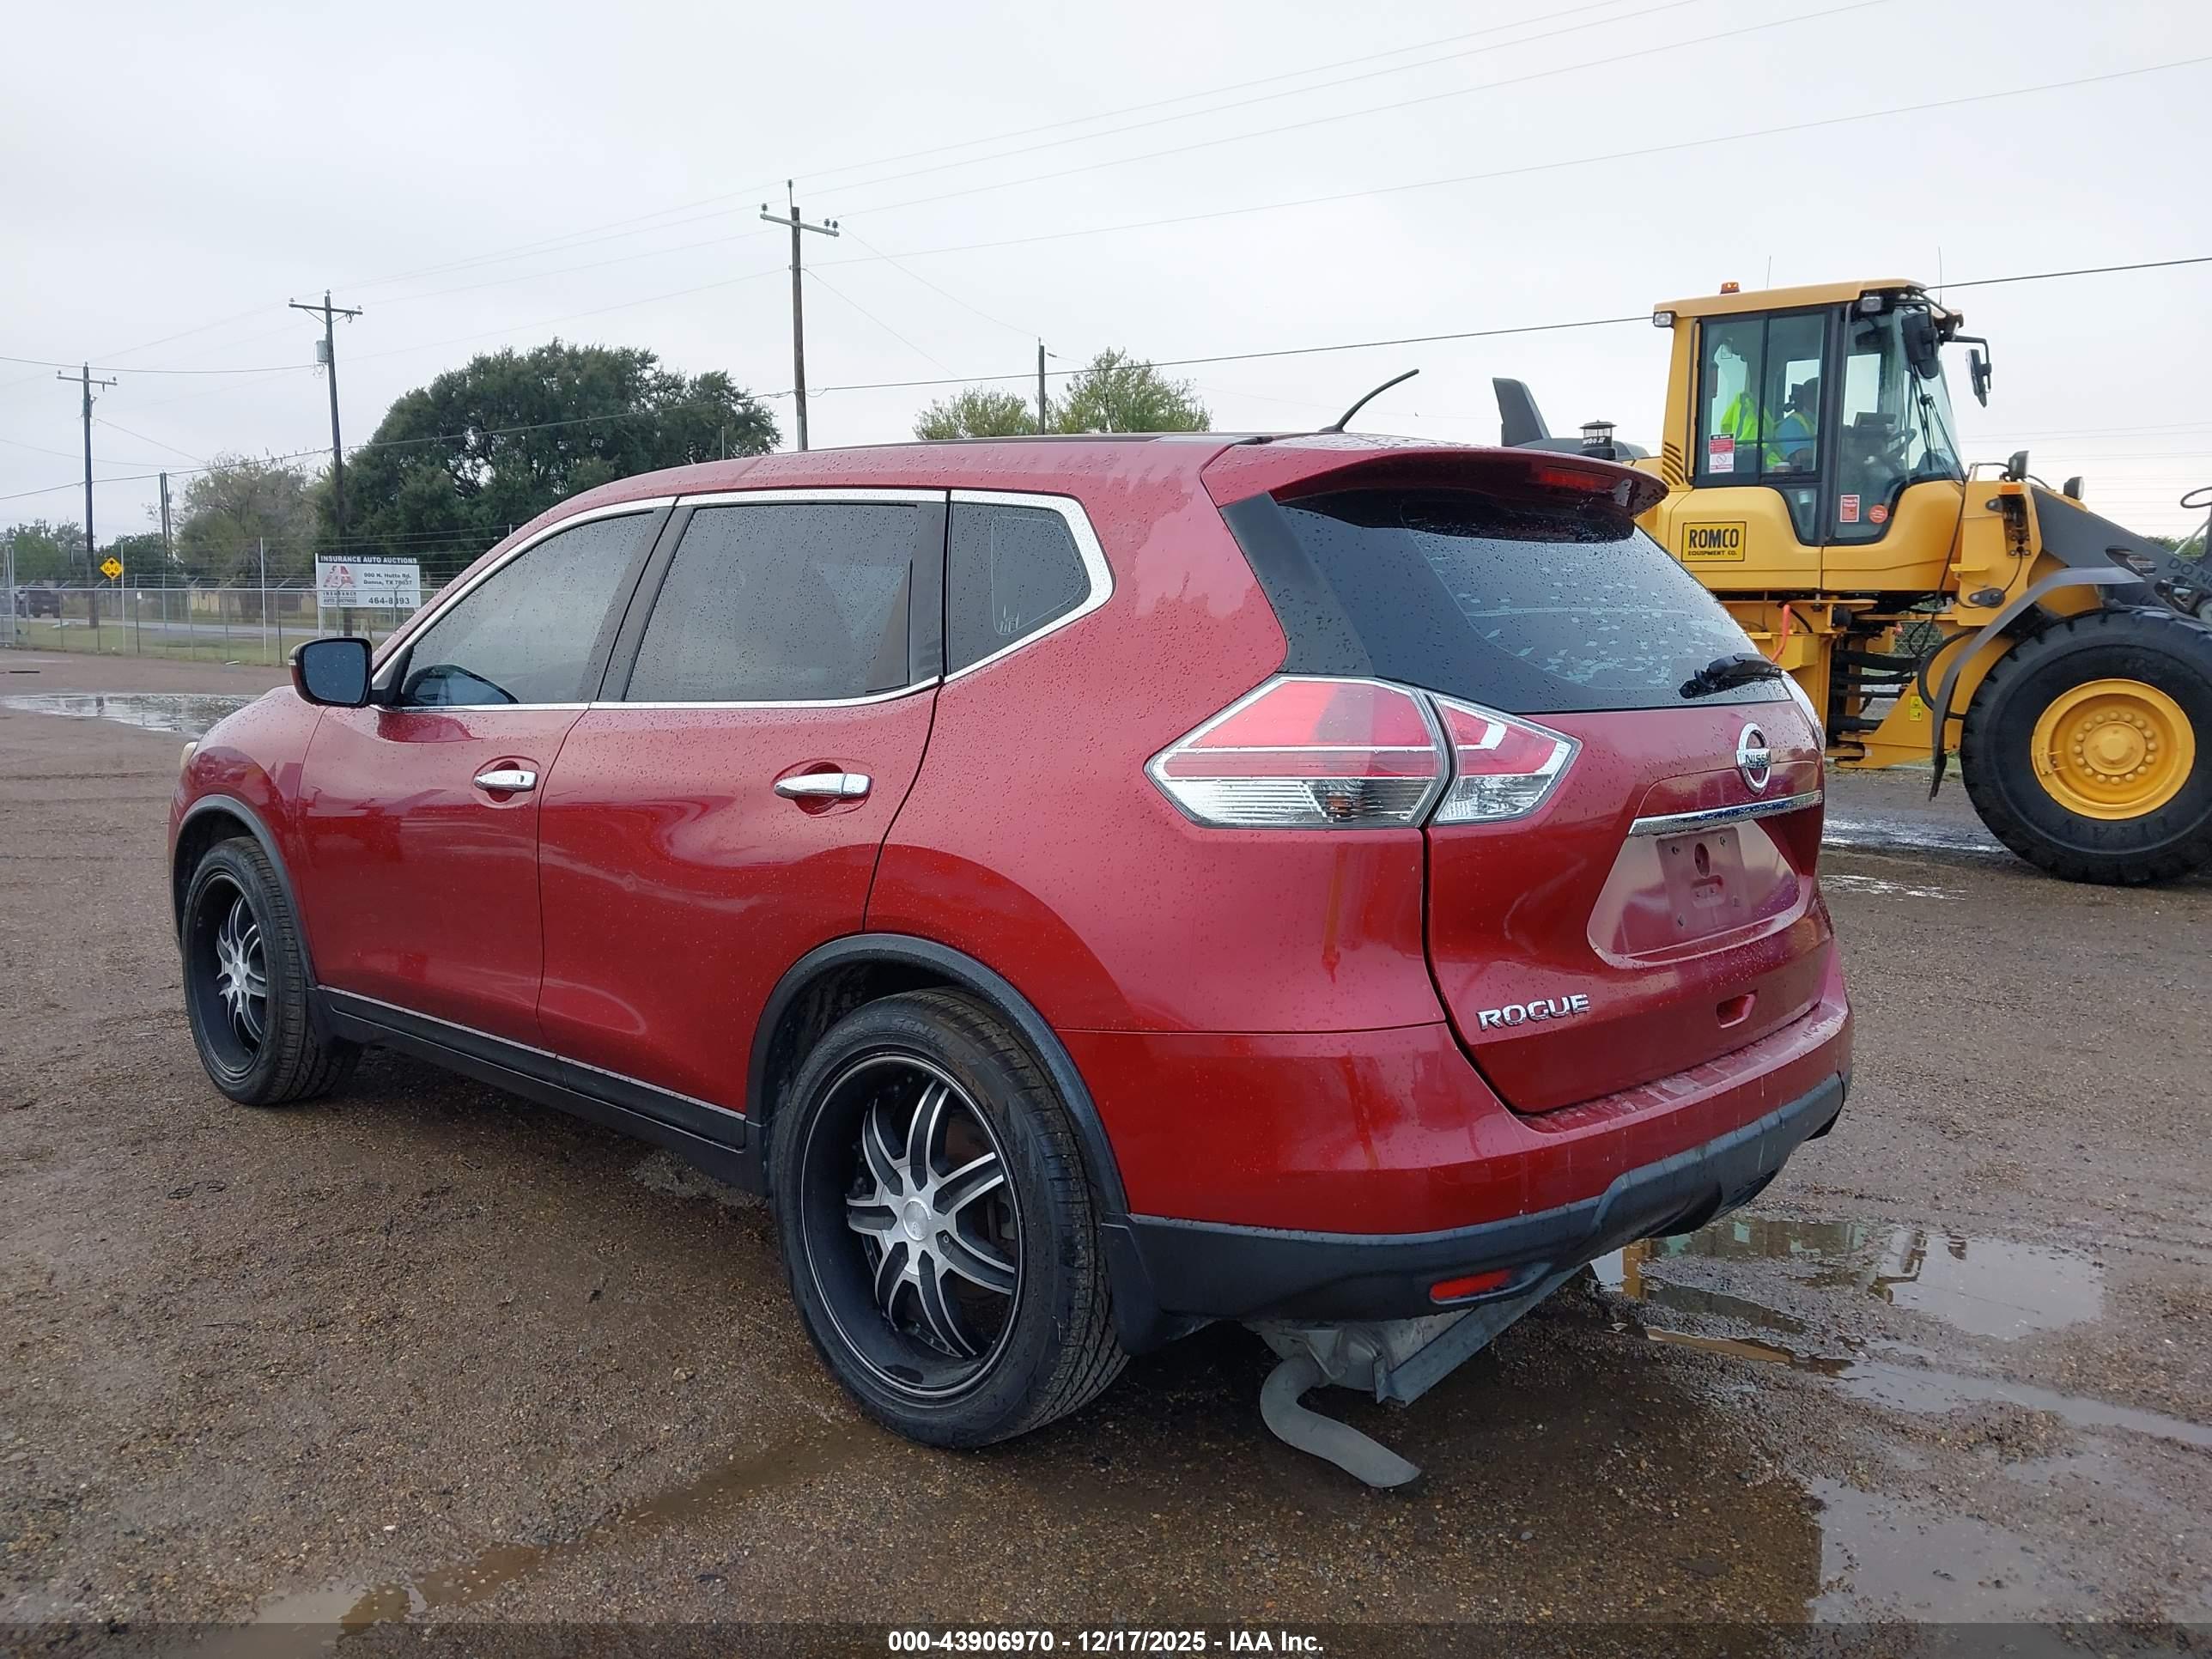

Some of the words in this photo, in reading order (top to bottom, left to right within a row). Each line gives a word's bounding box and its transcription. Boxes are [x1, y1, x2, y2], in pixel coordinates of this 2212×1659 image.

[1688, 528, 1740, 549] ROMCO
[2168, 557, 2193, 575] DO
[1476, 994, 1591, 1031] ROGUE
